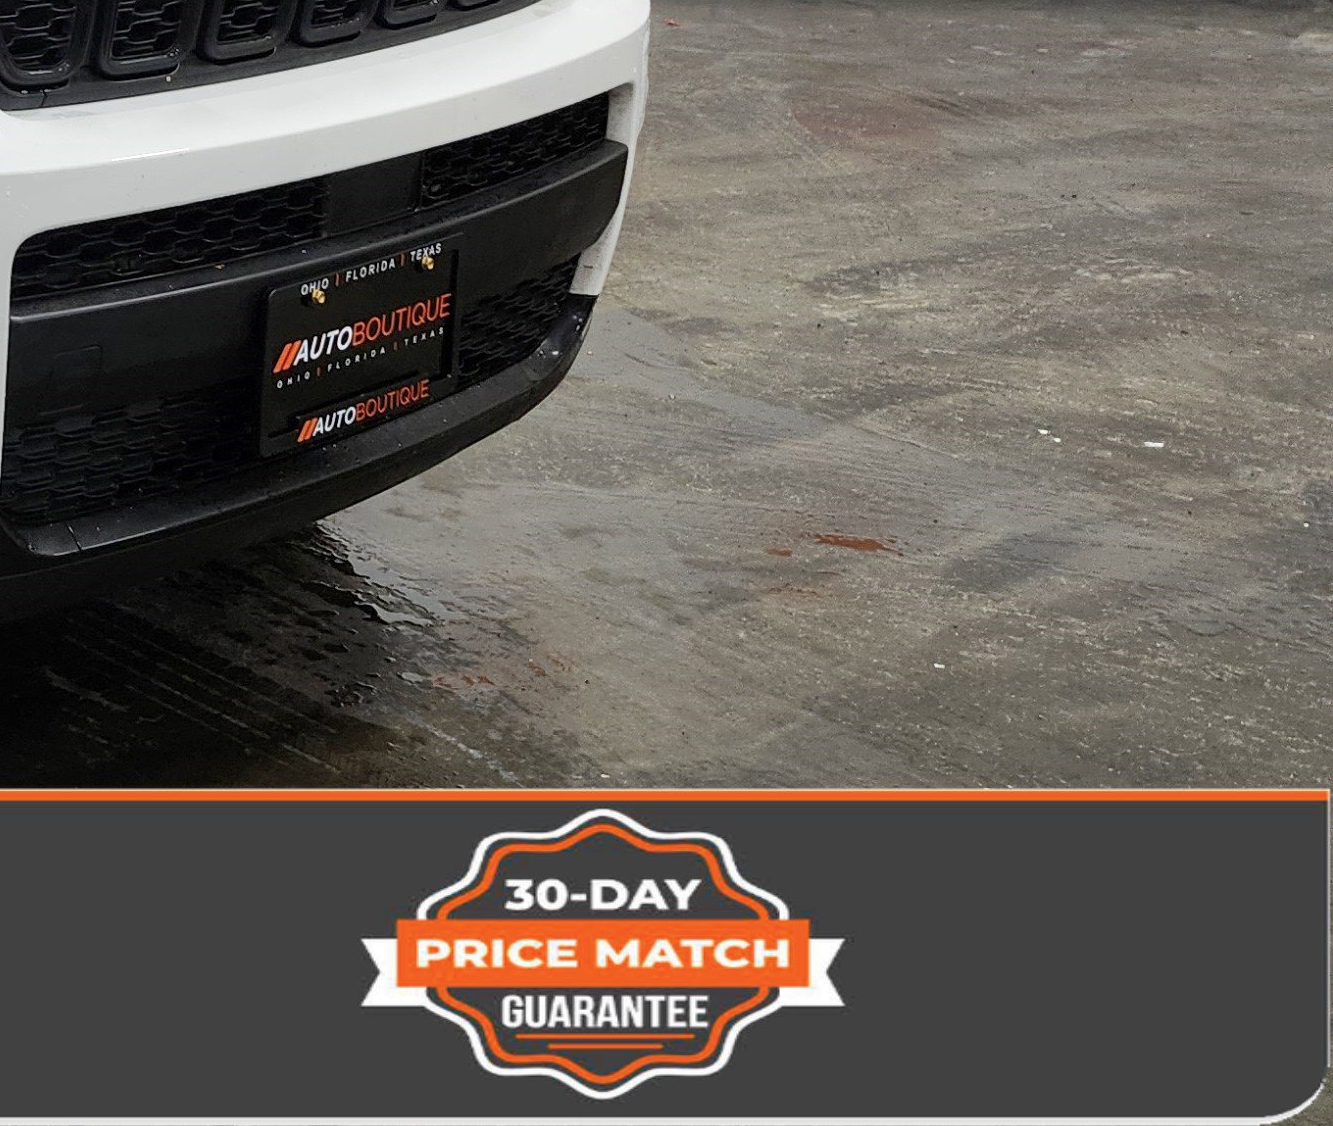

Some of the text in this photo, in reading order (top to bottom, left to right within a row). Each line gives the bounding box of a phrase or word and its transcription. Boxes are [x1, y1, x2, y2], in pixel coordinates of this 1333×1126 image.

[300, 242, 442, 296] OHIO FLORIDA TEXAS
[276, 326, 444, 389] OHIO FLORIDA TEXAS
[293, 292, 452, 366] AUTOBOUTIQUE
[312, 378, 430, 437] AUTOBOUTIQUE
